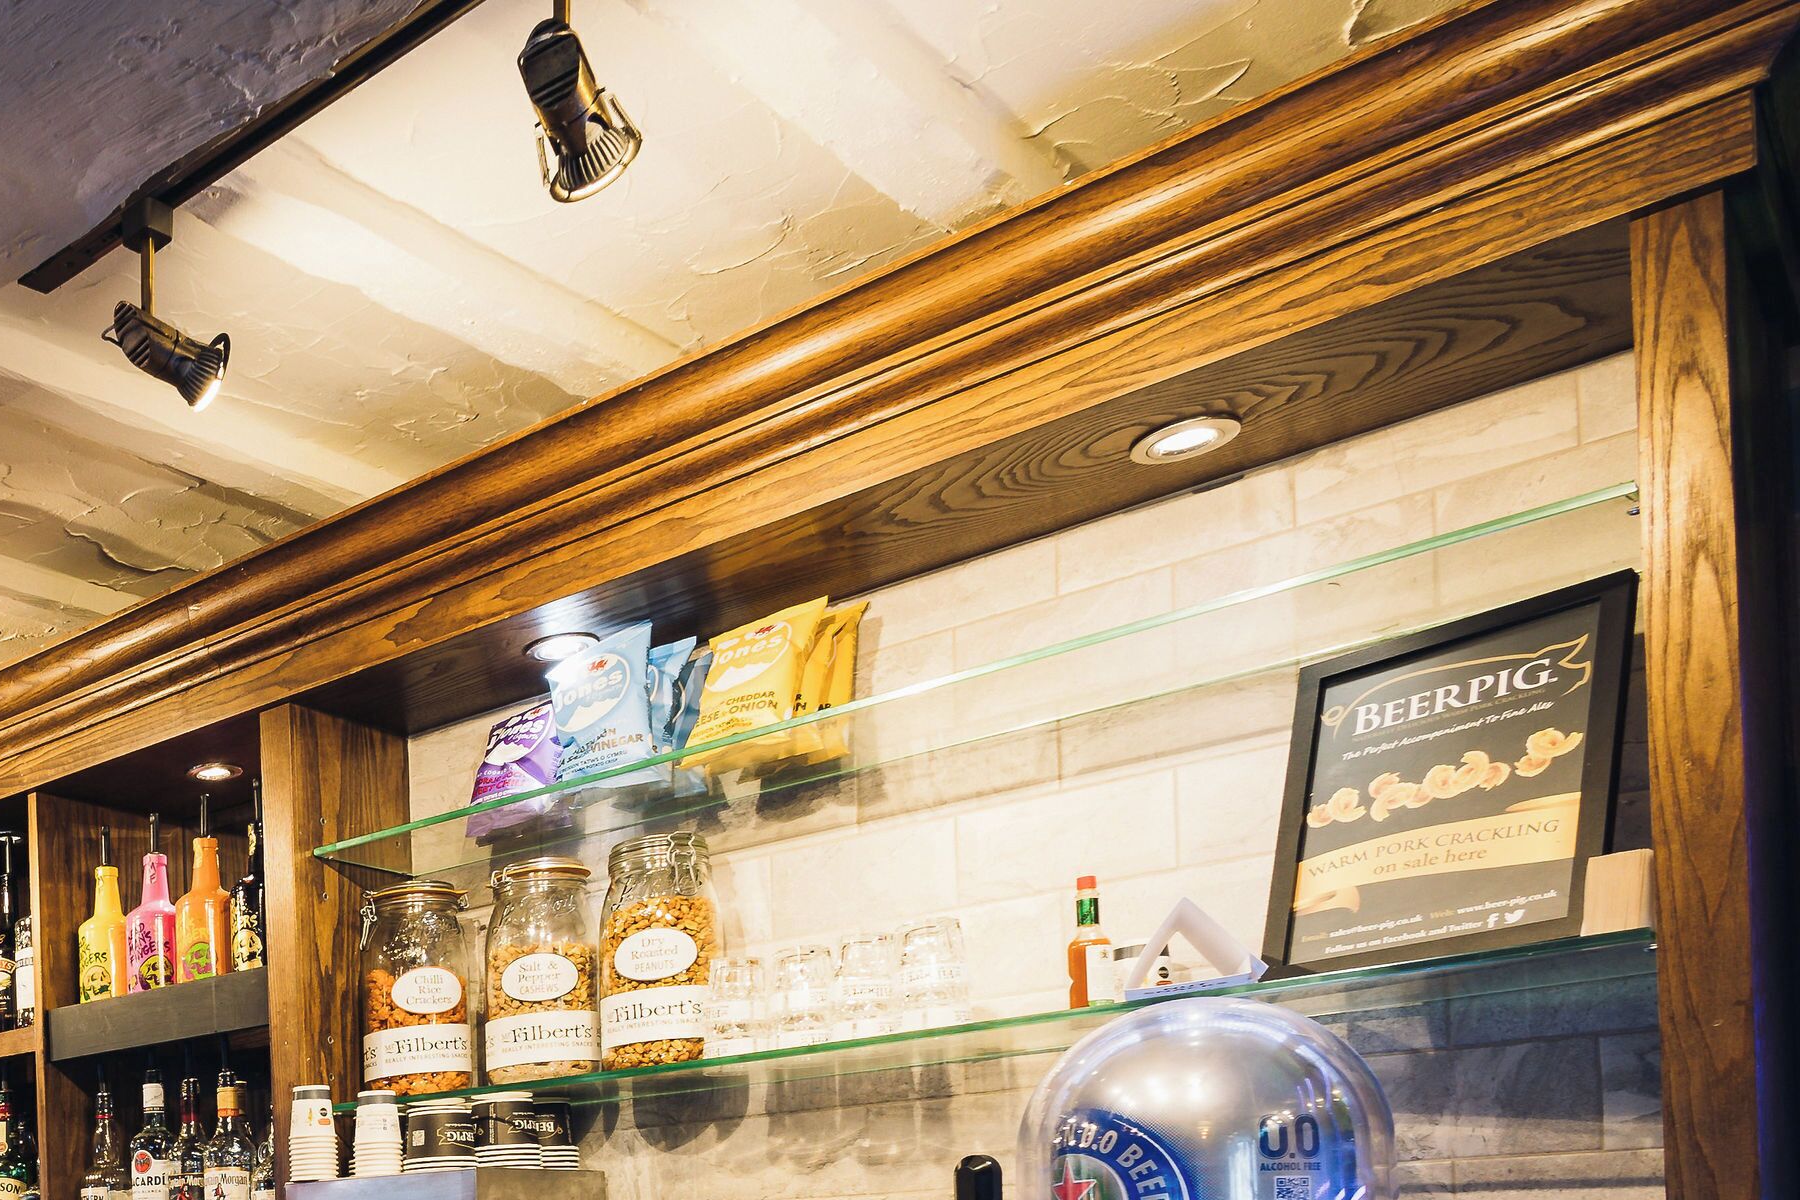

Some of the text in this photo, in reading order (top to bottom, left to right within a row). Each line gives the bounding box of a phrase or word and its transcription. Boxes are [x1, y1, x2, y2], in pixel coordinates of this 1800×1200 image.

[725, 691, 775, 705] CHEDDAR
[1352, 658, 1553, 736] BEERPIG
[728, 700, 778, 714] ONION
[590, 734, 644, 754] VINEGAR
[1307, 819, 1561, 878] WARM PORK CRACKLING
[1373, 847, 1488, 876] on sale here
[1383, 929, 1427, 944] Facebook
[1448, 918, 1483, 932] Twitter
[641, 938, 665, 948] Dry
[631, 945, 678, 960] Roasted
[518, 962, 541, 972] Salt
[634, 959, 674, 973] PEANUTS
[414, 975, 444, 985] Chilli
[517, 972, 561, 984] Pepper
[418, 986, 441, 995] Rice
[406, 994, 453, 1006] Crackers
[614, 1000, 702, 1023] Filbert's
[511, 1024, 592, 1043] Filbert's
[394, 1036, 468, 1055] Filbert's
[1258, 1114, 1319, 1159] 0.0
[1260, 1161, 1321, 1171] ALCOHOL FREE
[133, 1172, 166, 1186] CARDÍ
[219, 1173, 248, 1186] Morgan
